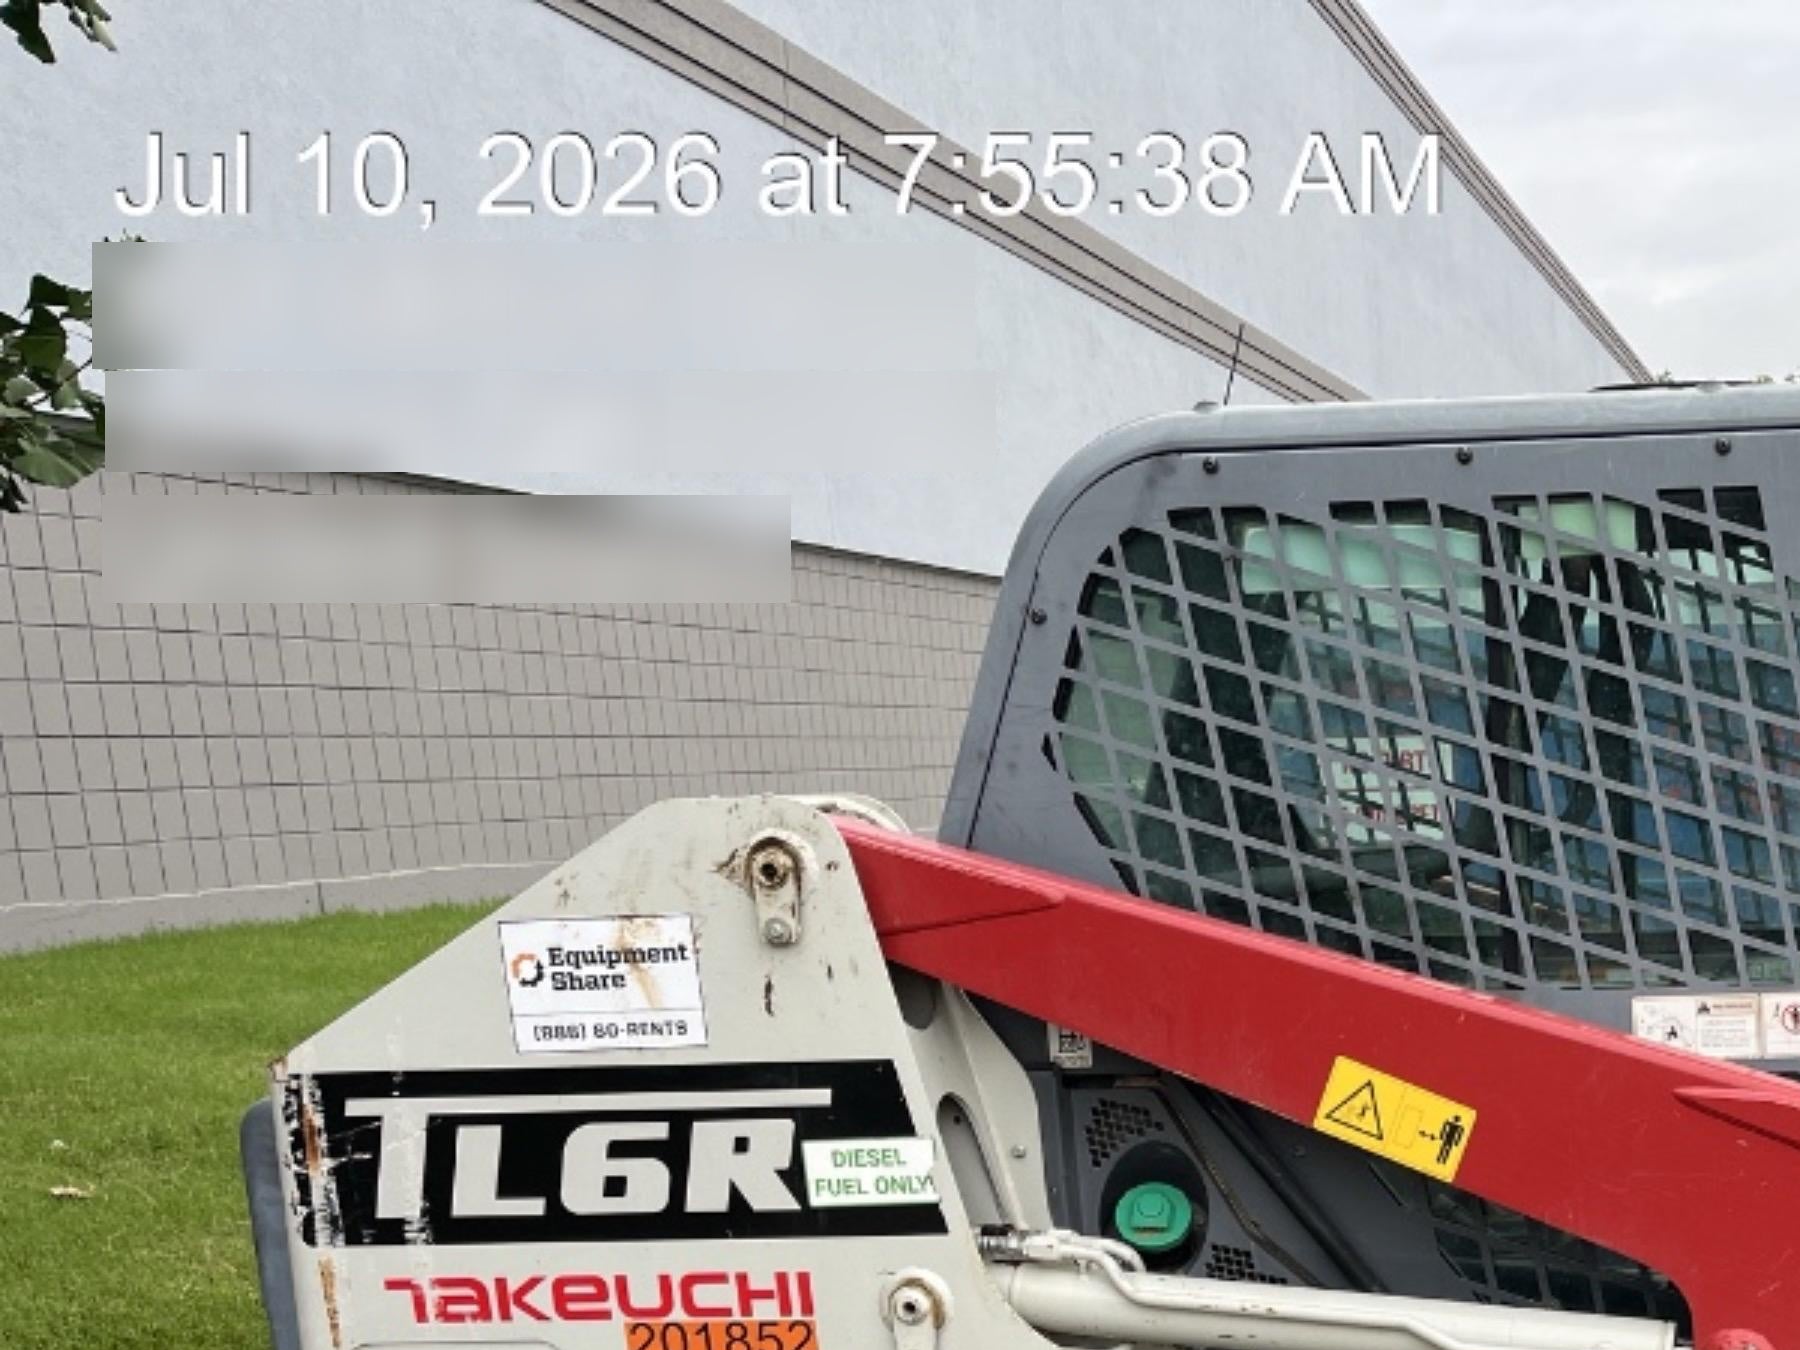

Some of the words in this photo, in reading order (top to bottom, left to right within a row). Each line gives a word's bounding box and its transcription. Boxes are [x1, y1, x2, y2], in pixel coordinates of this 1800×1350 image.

[547, 944, 689, 969] Equipment
[552, 971, 626, 991] Share
[593, 1020, 689, 1039] 60-RENTS
[345, 1088, 830, 1219] TL6R
[831, 1148, 907, 1168] DIESEL
[815, 1177, 869, 1196] FUEL
